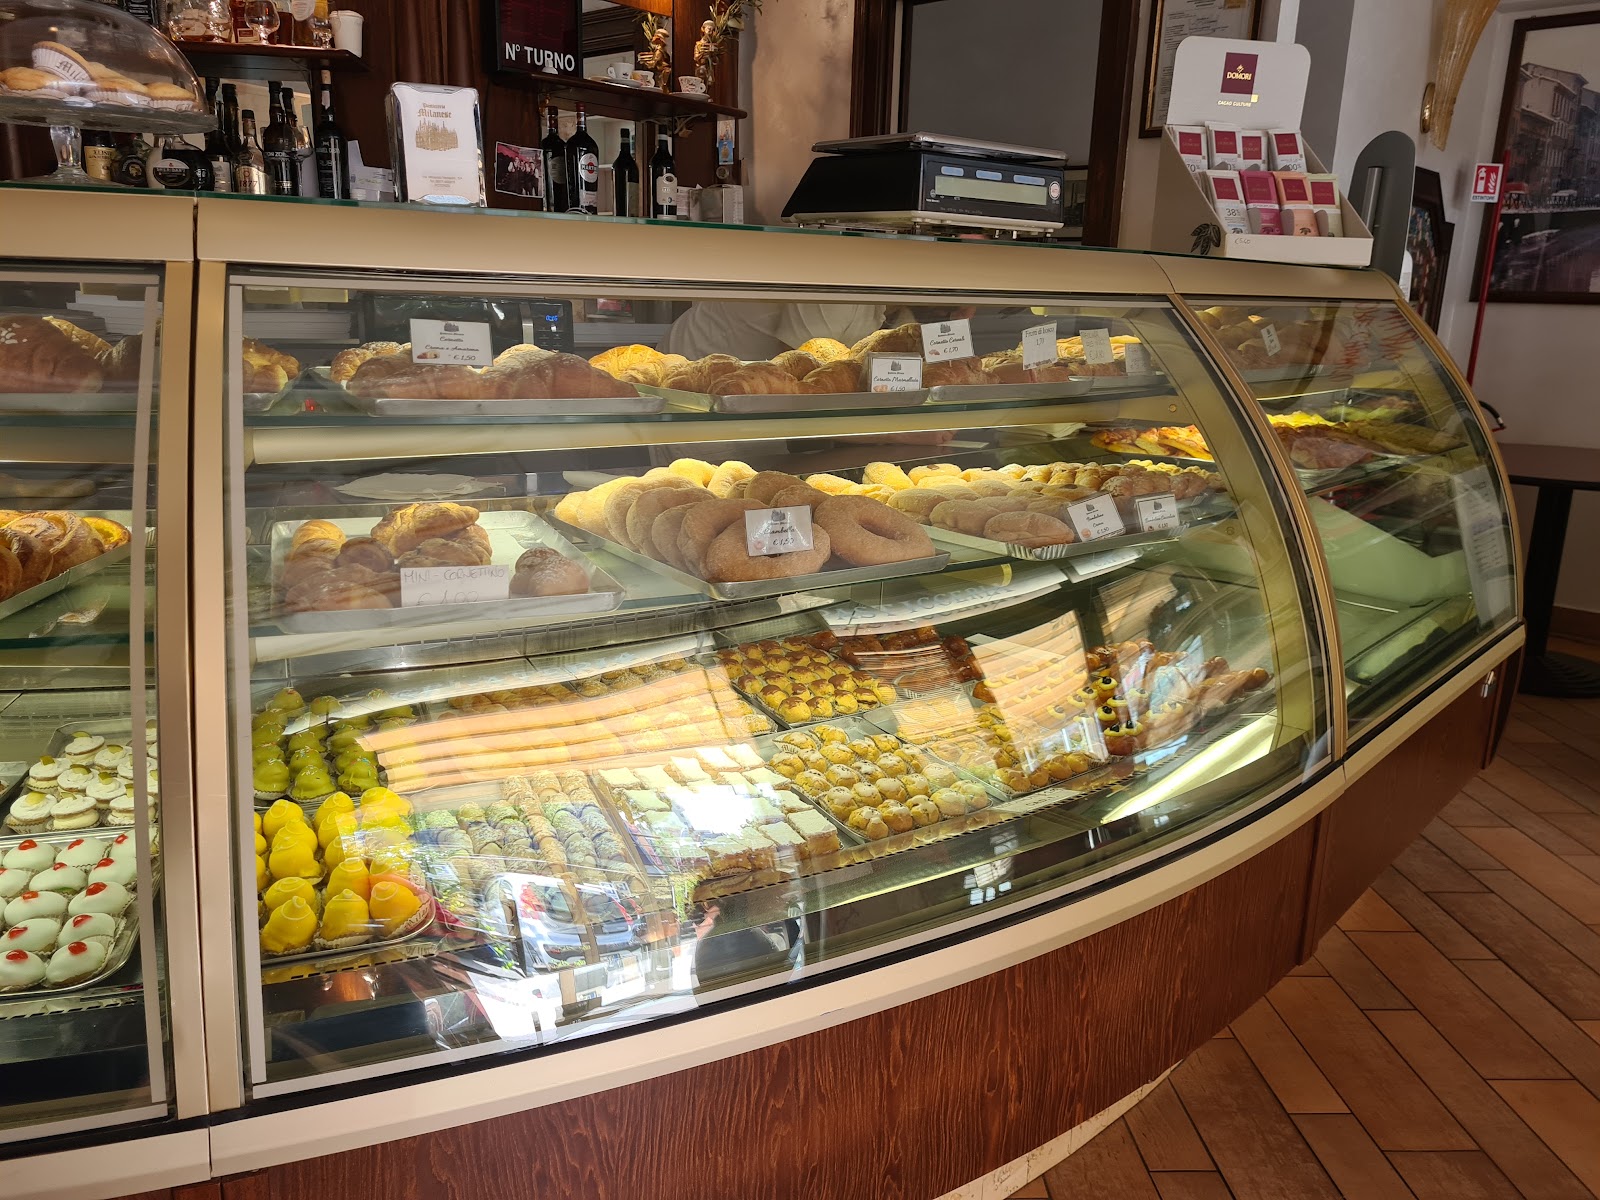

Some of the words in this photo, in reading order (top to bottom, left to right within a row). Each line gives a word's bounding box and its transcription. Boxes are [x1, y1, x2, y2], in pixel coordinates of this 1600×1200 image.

[524, 46, 575, 71] TURNO
[1227, 71, 1252, 80] DOMORI
[417, 108, 452, 118] Milanese
